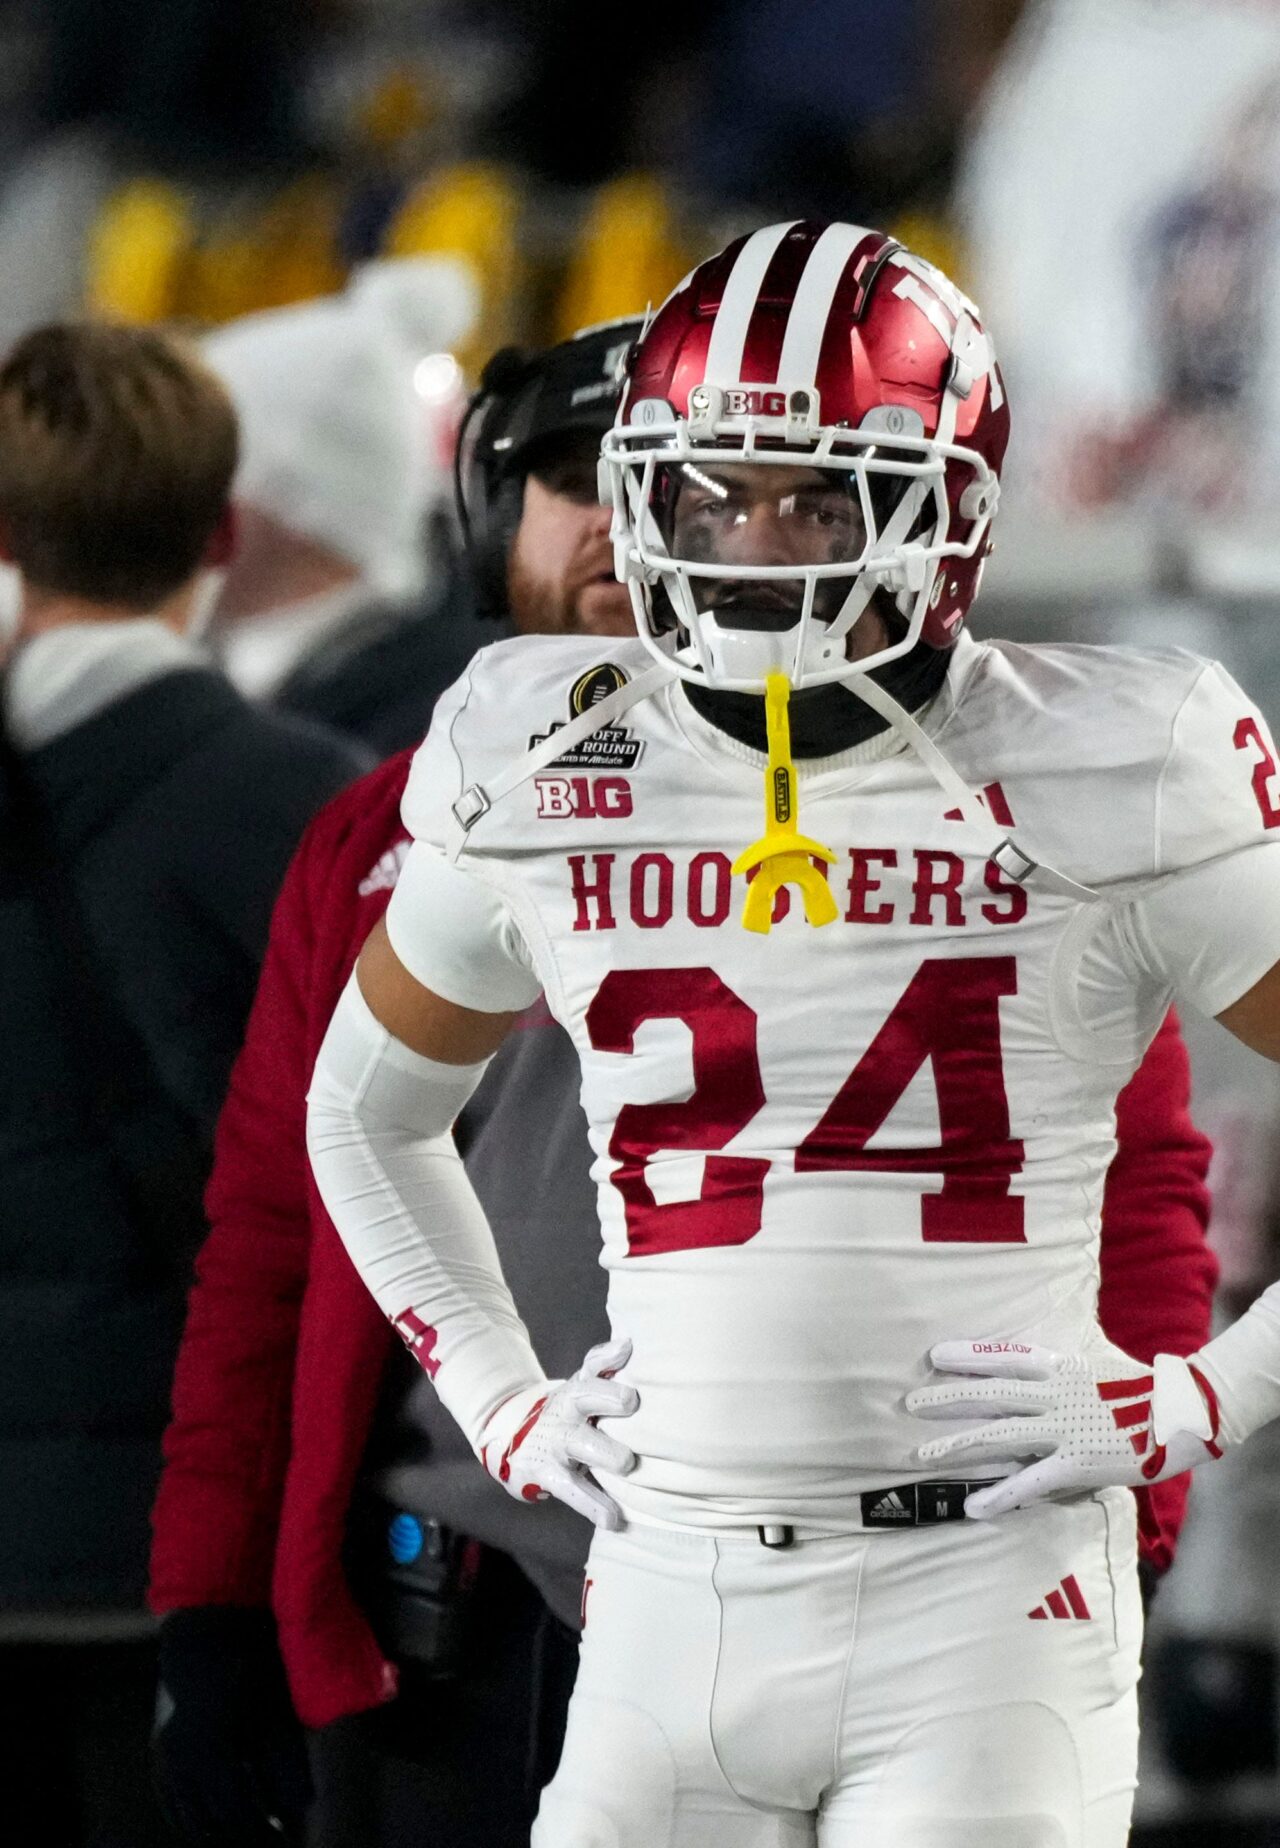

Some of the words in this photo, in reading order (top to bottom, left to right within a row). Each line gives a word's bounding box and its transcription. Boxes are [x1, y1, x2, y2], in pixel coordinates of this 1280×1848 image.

[582, 741, 636, 755] ROUND
[567, 847, 1029, 932] HOOERS
[584, 956, 1028, 1258] 24
[972, 1343, 1032, 1354] ADIZERO
[870, 1509, 913, 1519] adidas
[936, 1501, 948, 1517] M
